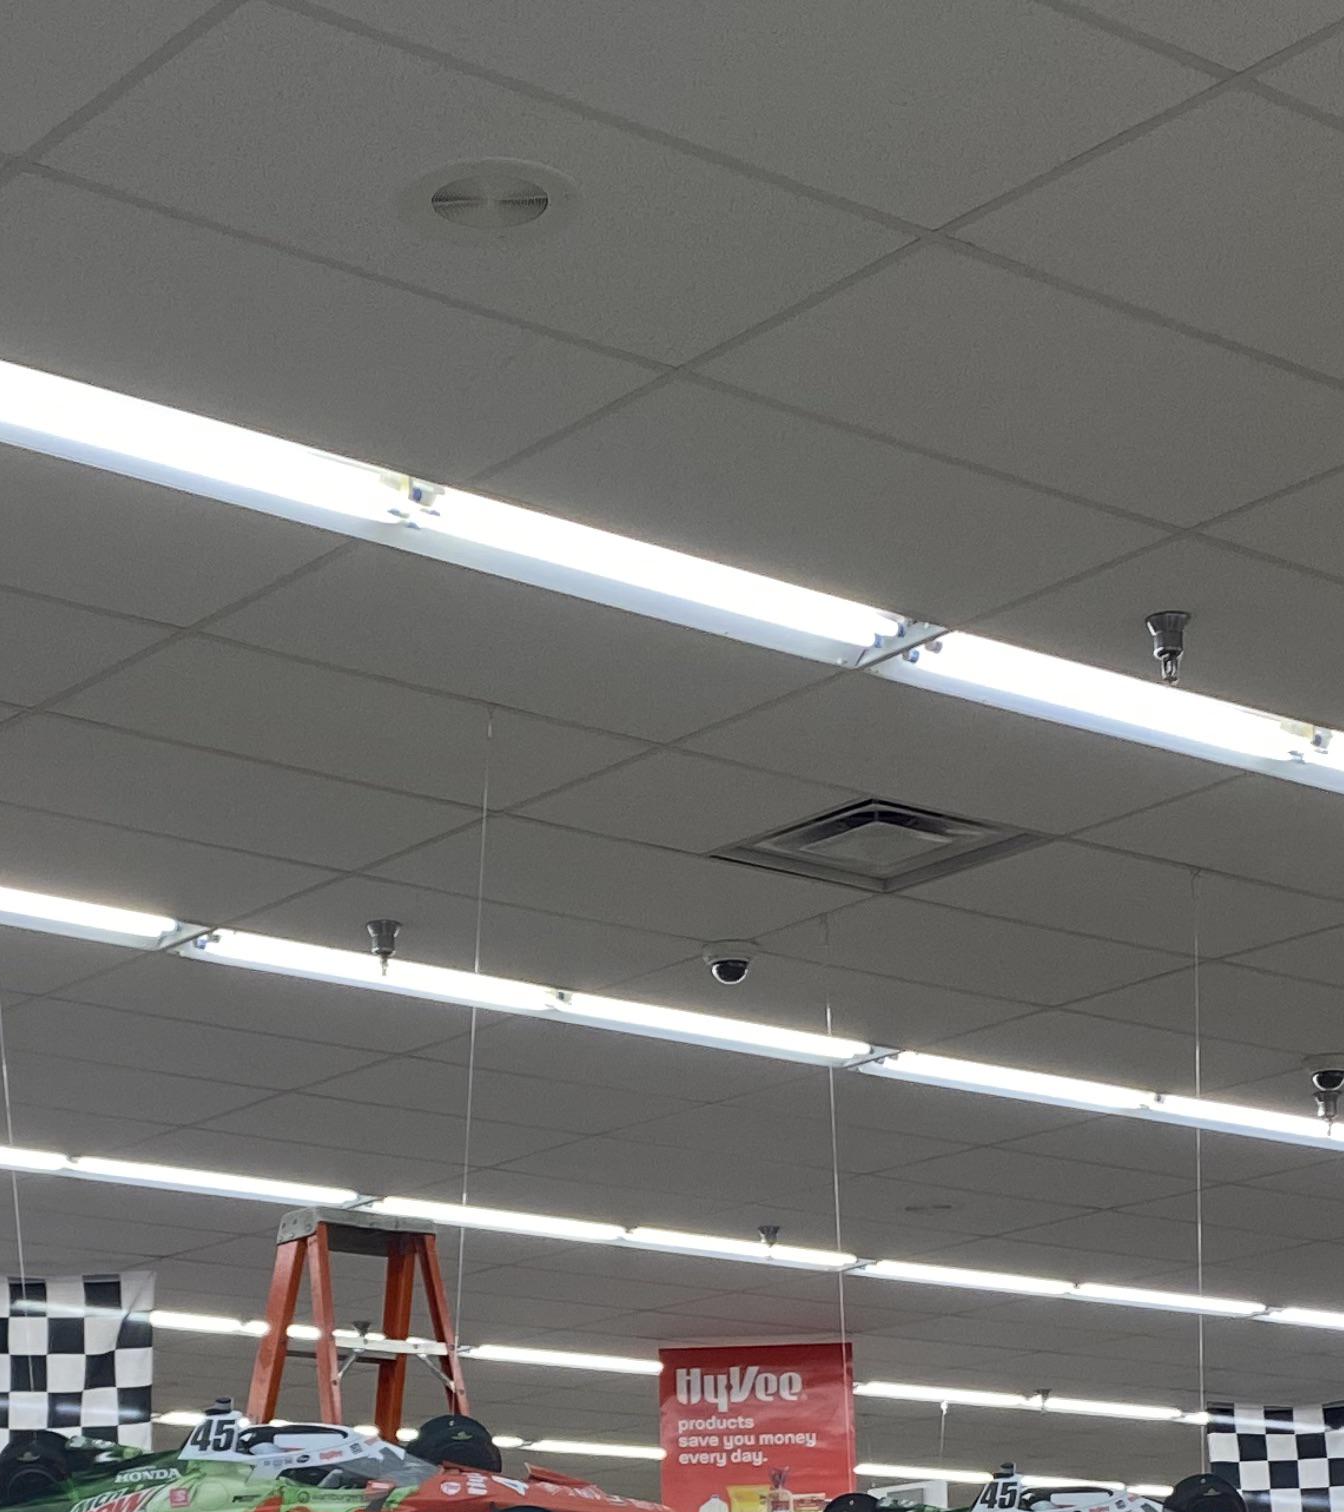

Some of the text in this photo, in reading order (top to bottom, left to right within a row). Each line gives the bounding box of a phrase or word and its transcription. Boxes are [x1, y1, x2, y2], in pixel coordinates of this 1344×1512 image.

[675, 1365, 803, 1412] HyVee
[678, 1415, 755, 1433] products
[190, 1418, 236, 1451] 45
[678, 1431, 817, 1449] save you money
[678, 1449, 769, 1467] every day.
[114, 1468, 182, 1484] HONDA
[980, 1480, 1018, 1509] 45
